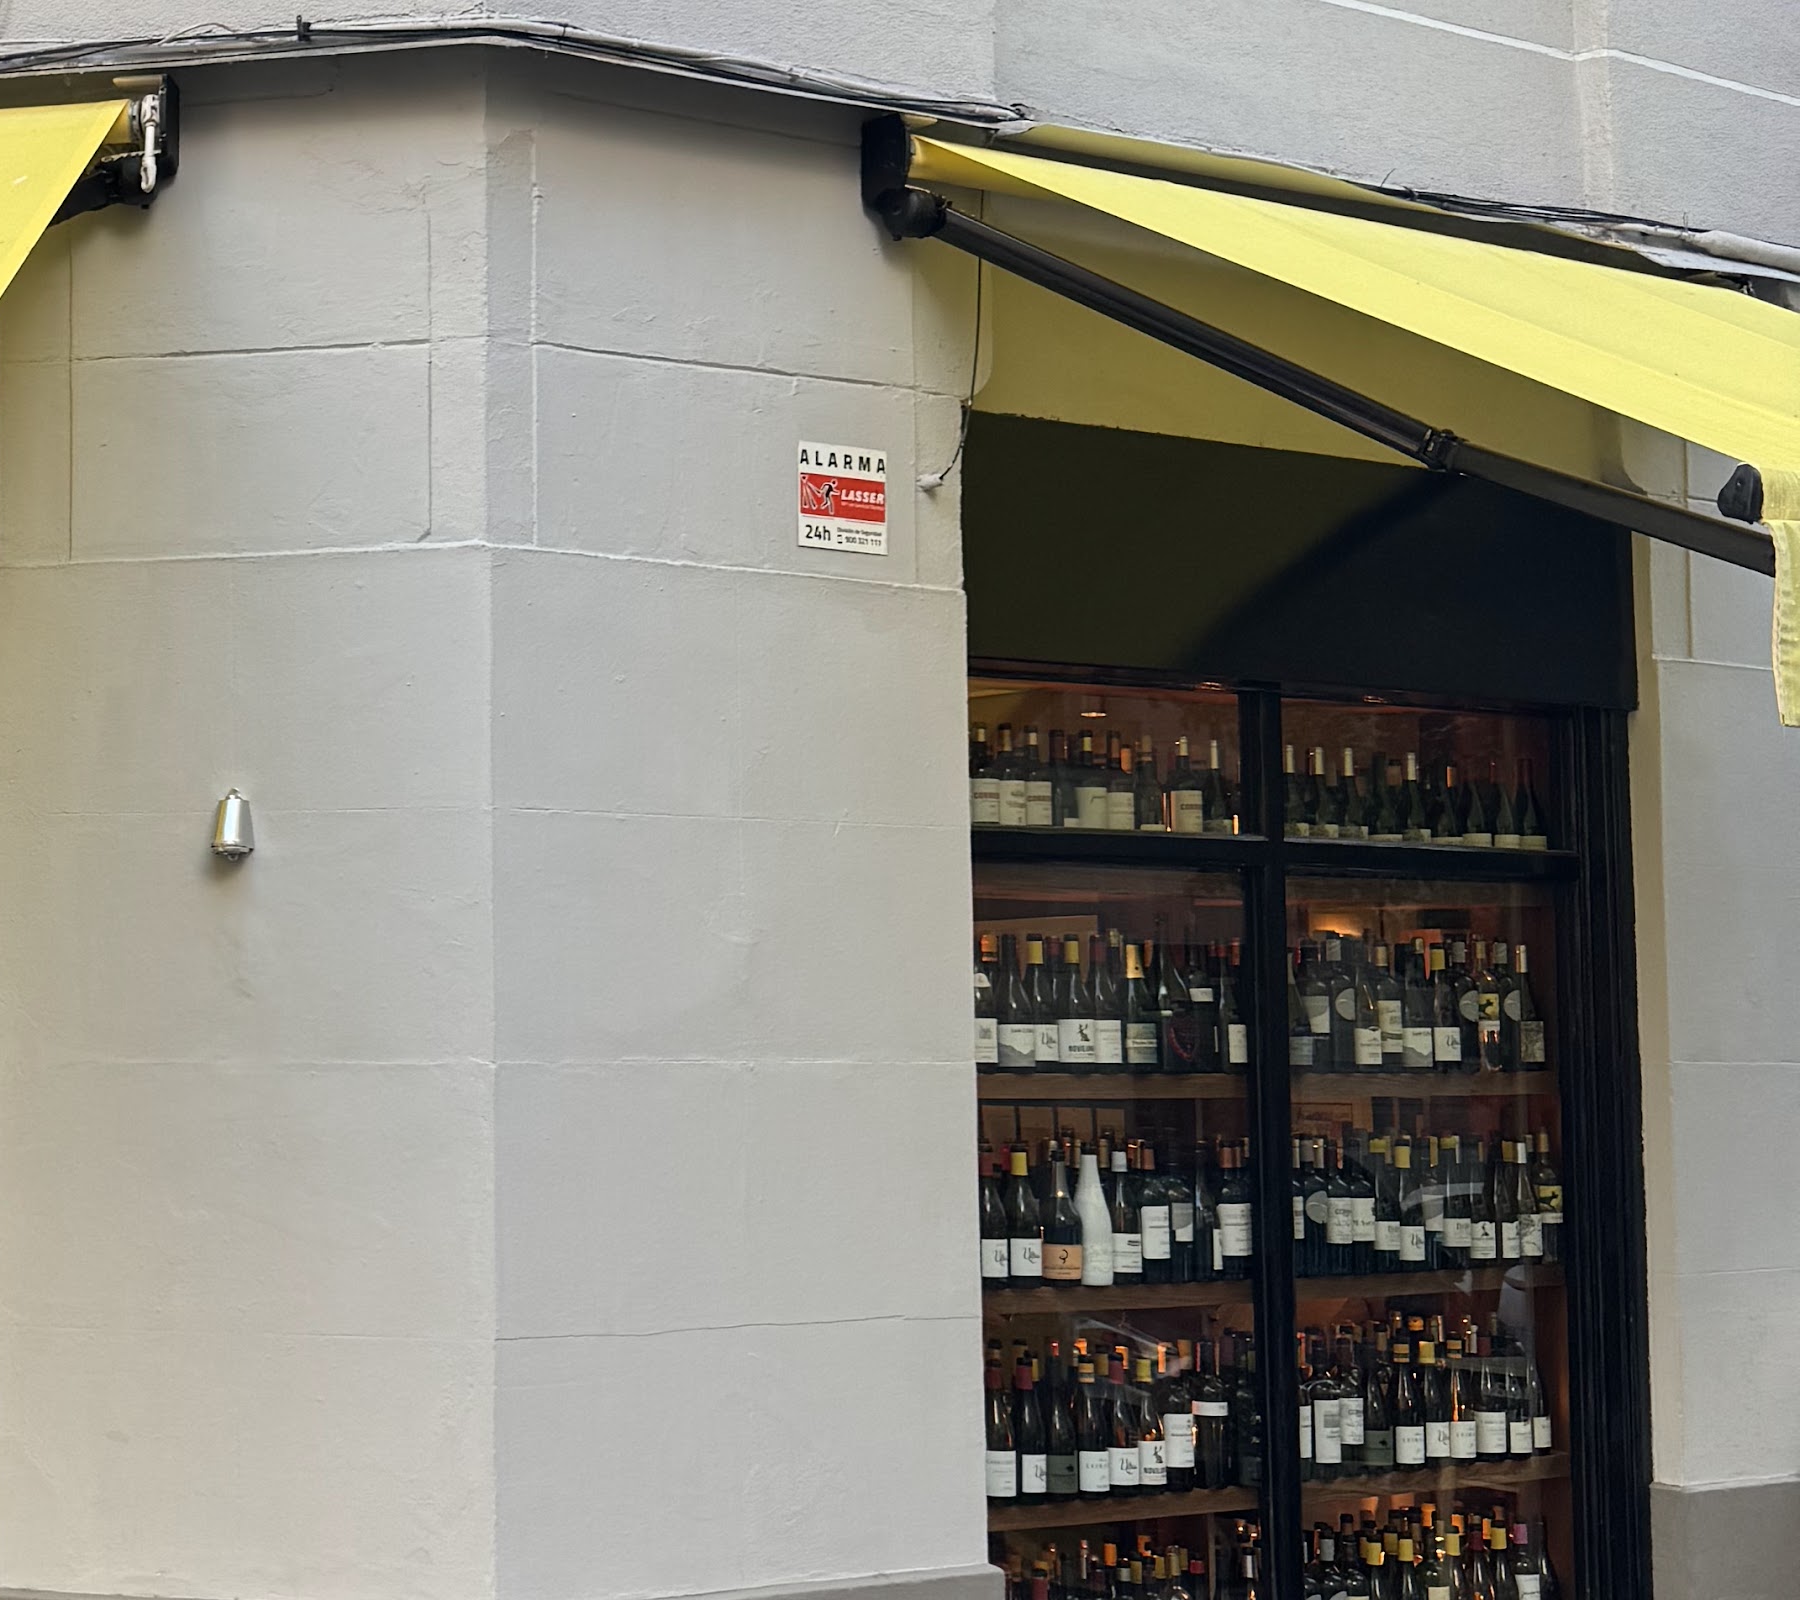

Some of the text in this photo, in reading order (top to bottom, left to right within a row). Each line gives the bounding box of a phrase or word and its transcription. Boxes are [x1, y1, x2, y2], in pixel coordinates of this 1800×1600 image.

[800, 448, 886, 475] ALARMA
[841, 488, 885, 505] LASSER
[805, 524, 831, 542] 24h
